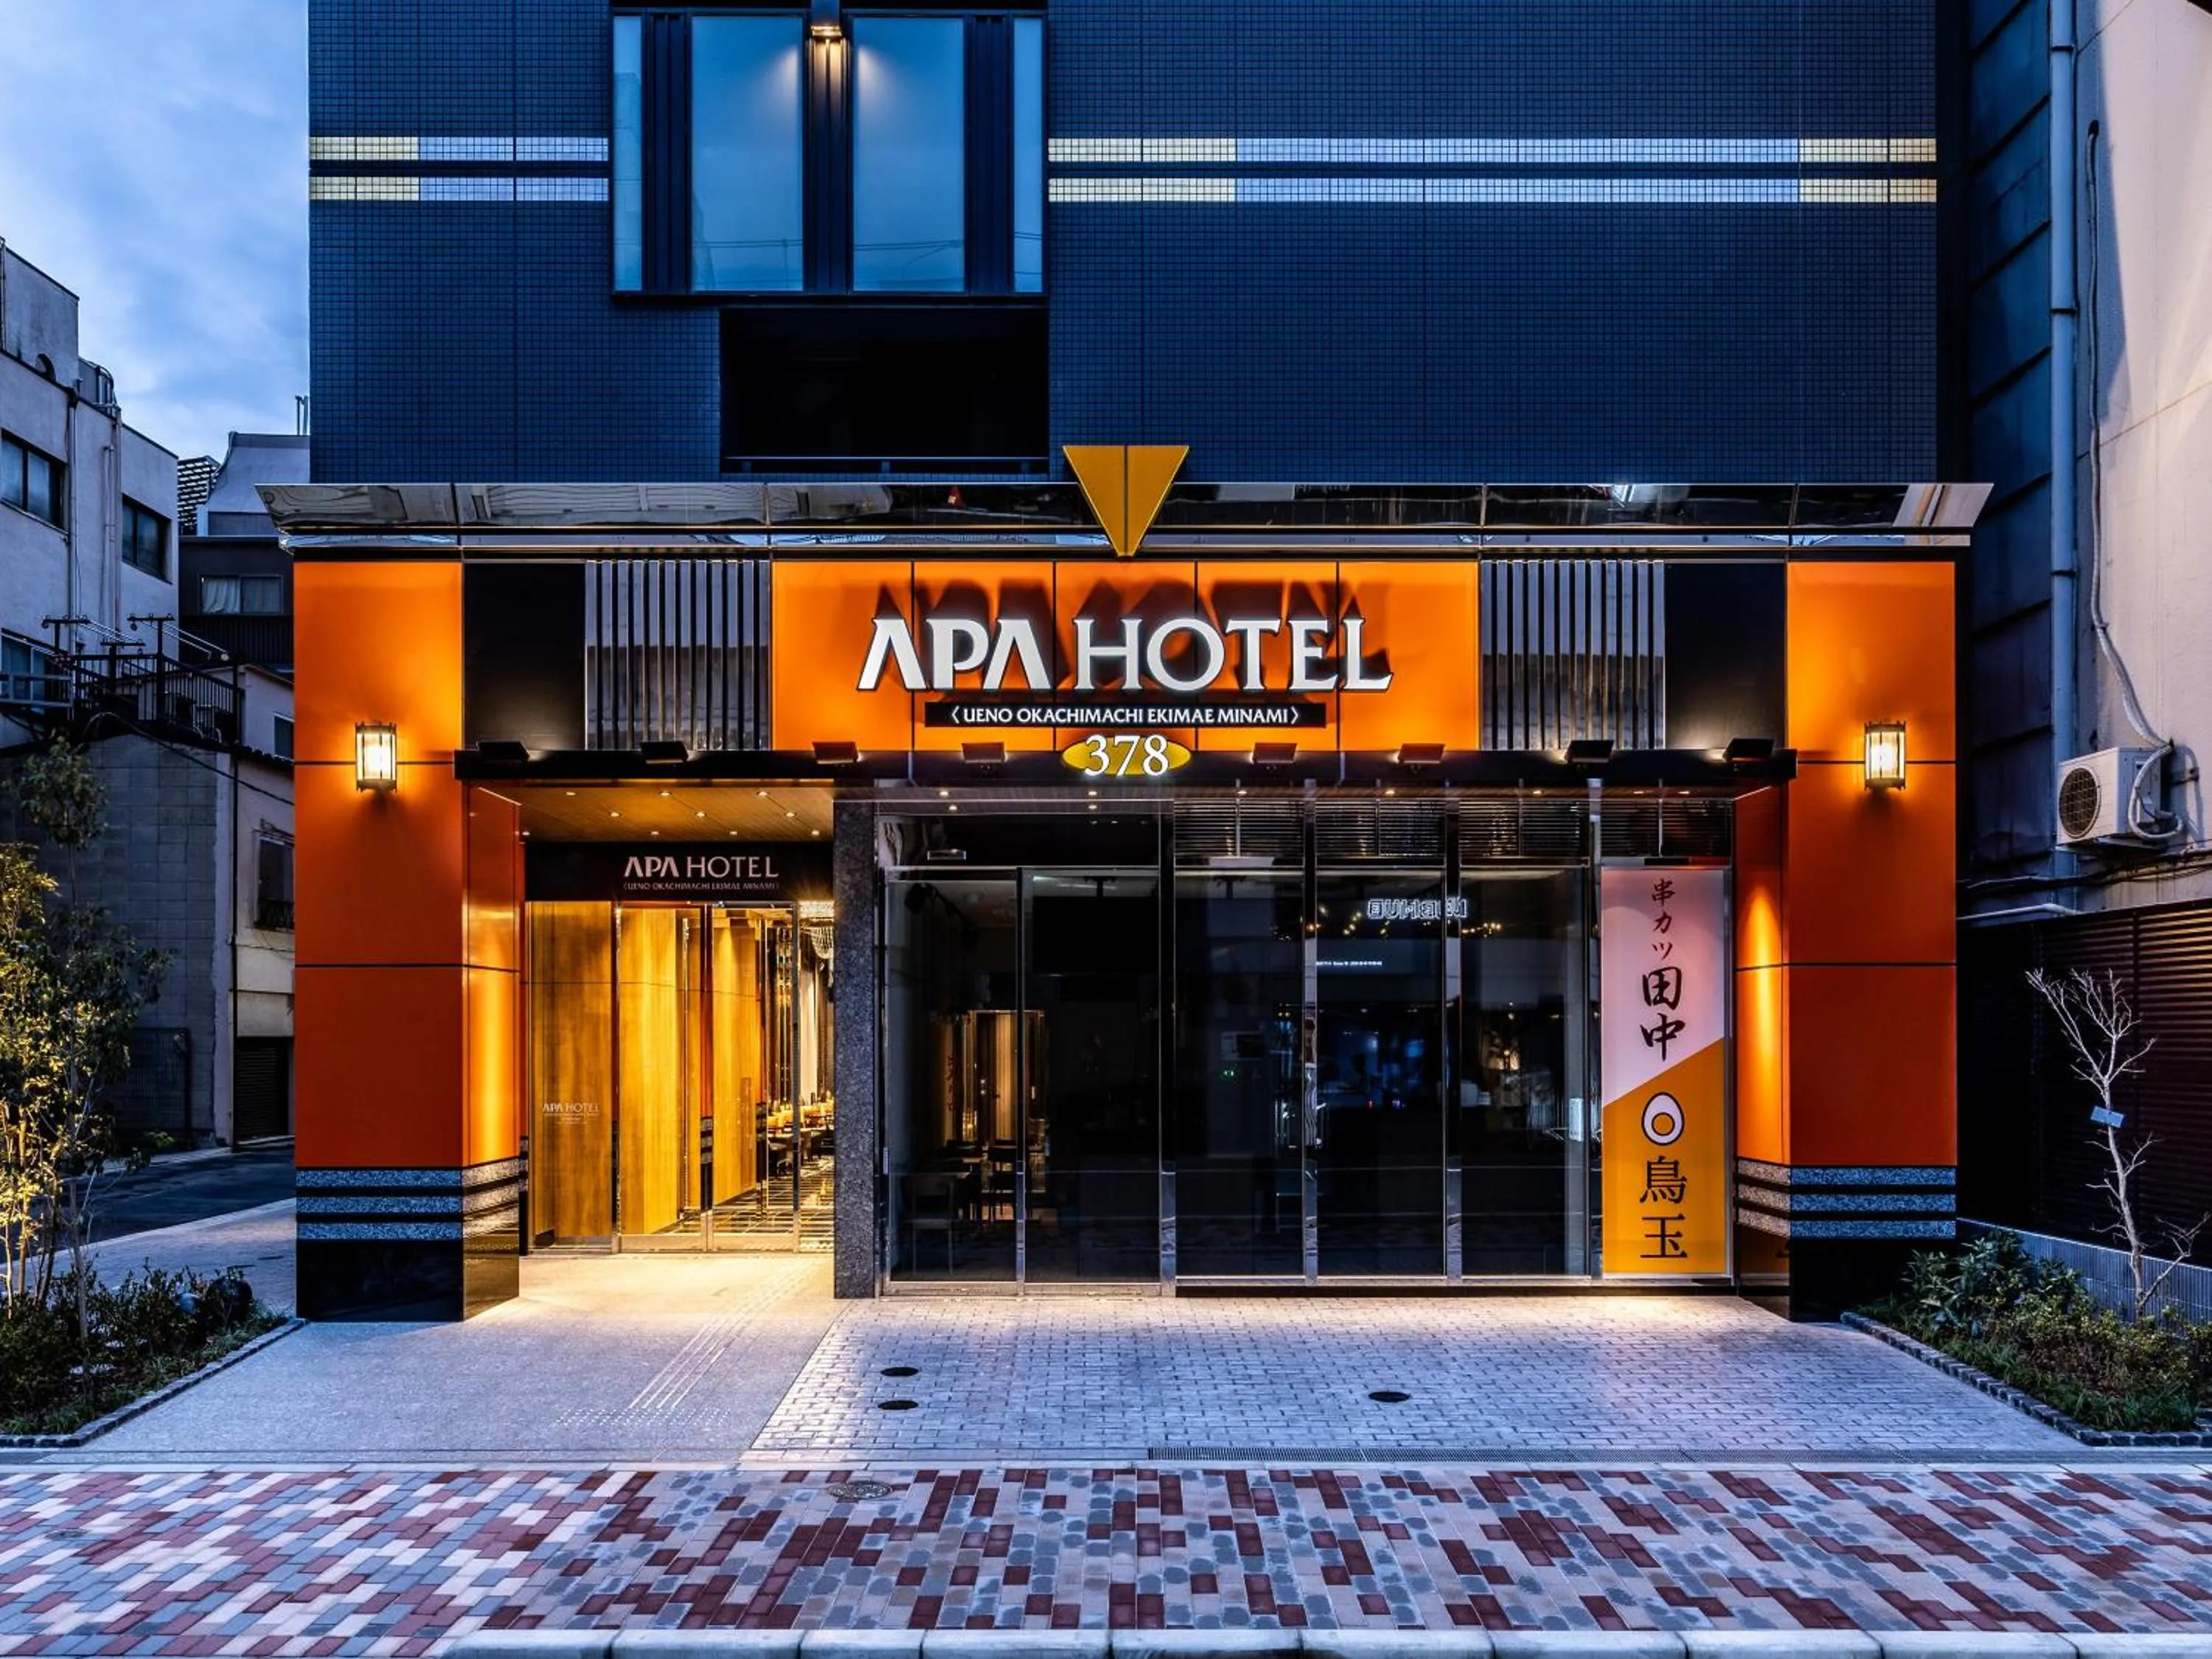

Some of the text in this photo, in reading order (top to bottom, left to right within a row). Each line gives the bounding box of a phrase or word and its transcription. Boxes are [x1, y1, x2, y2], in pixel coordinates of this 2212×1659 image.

[858, 617, 1394, 692] APA HOTEL
[1017, 707, 1144, 724] OKACHIMACHI
[1147, 707, 1214, 724] EKIMAE
[1084, 734, 1171, 777] 378
[624, 856, 779, 878] APA HOTEL
[543, 1103, 563, 1112] APA
[1639, 1155, 1687, 1259] 鳥玉
